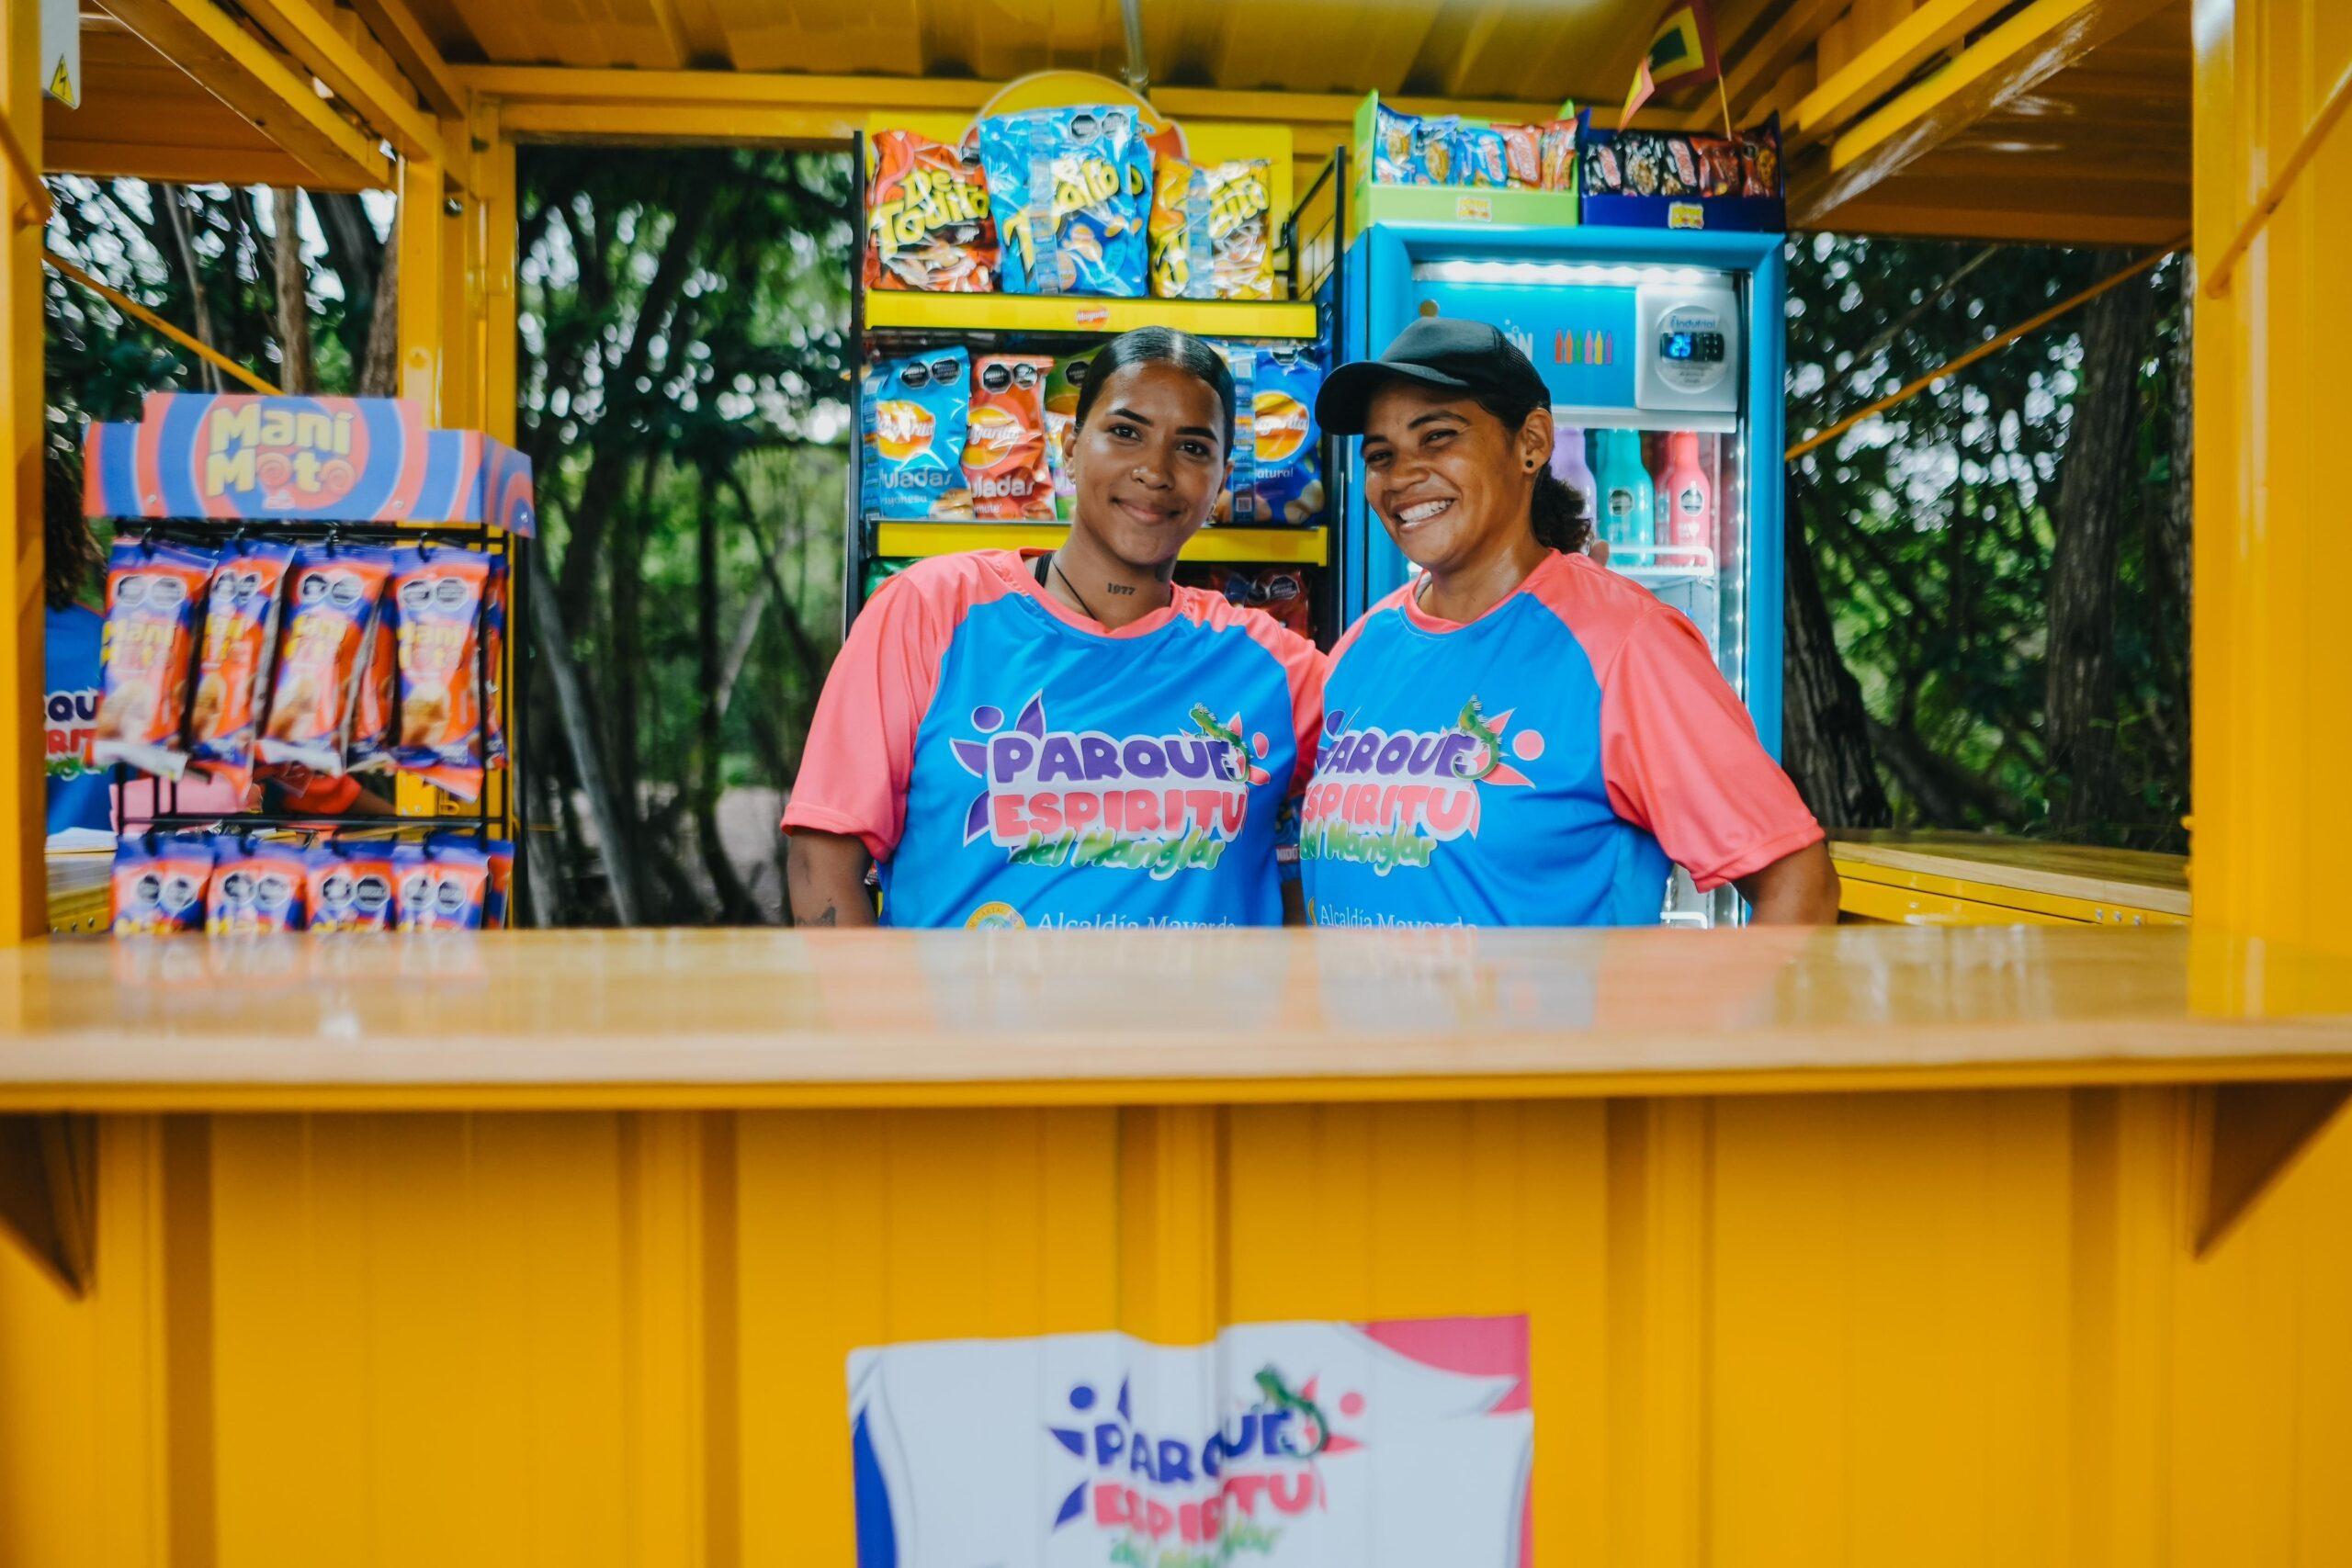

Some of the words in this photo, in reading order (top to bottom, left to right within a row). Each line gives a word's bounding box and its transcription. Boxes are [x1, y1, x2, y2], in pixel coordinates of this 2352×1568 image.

[899, 168, 954, 209] De
[867, 182, 990, 265] Todito
[205, 447, 356, 498] Moto
[880, 467, 953, 490] uladas
[1254, 467, 1294, 479] atural
[1107, 582, 1136, 596] 1977
[48, 695, 98, 722] QU
[992, 736, 1236, 783] PARQUE
[1324, 732, 1477, 779] ARQUE
[993, 788, 1247, 838] ESPIRITU
[1302, 783, 1470, 832] SPIRITU
[1010, 829, 1075, 866] del
[1073, 829, 1225, 877] Manglar
[1327, 819, 1436, 874] Manglar
[1038, 912, 1139, 930] Alcaldía
[1320, 904, 1373, 928] Alcaldía
[1093, 1472, 1315, 1545] ESPIRTU
